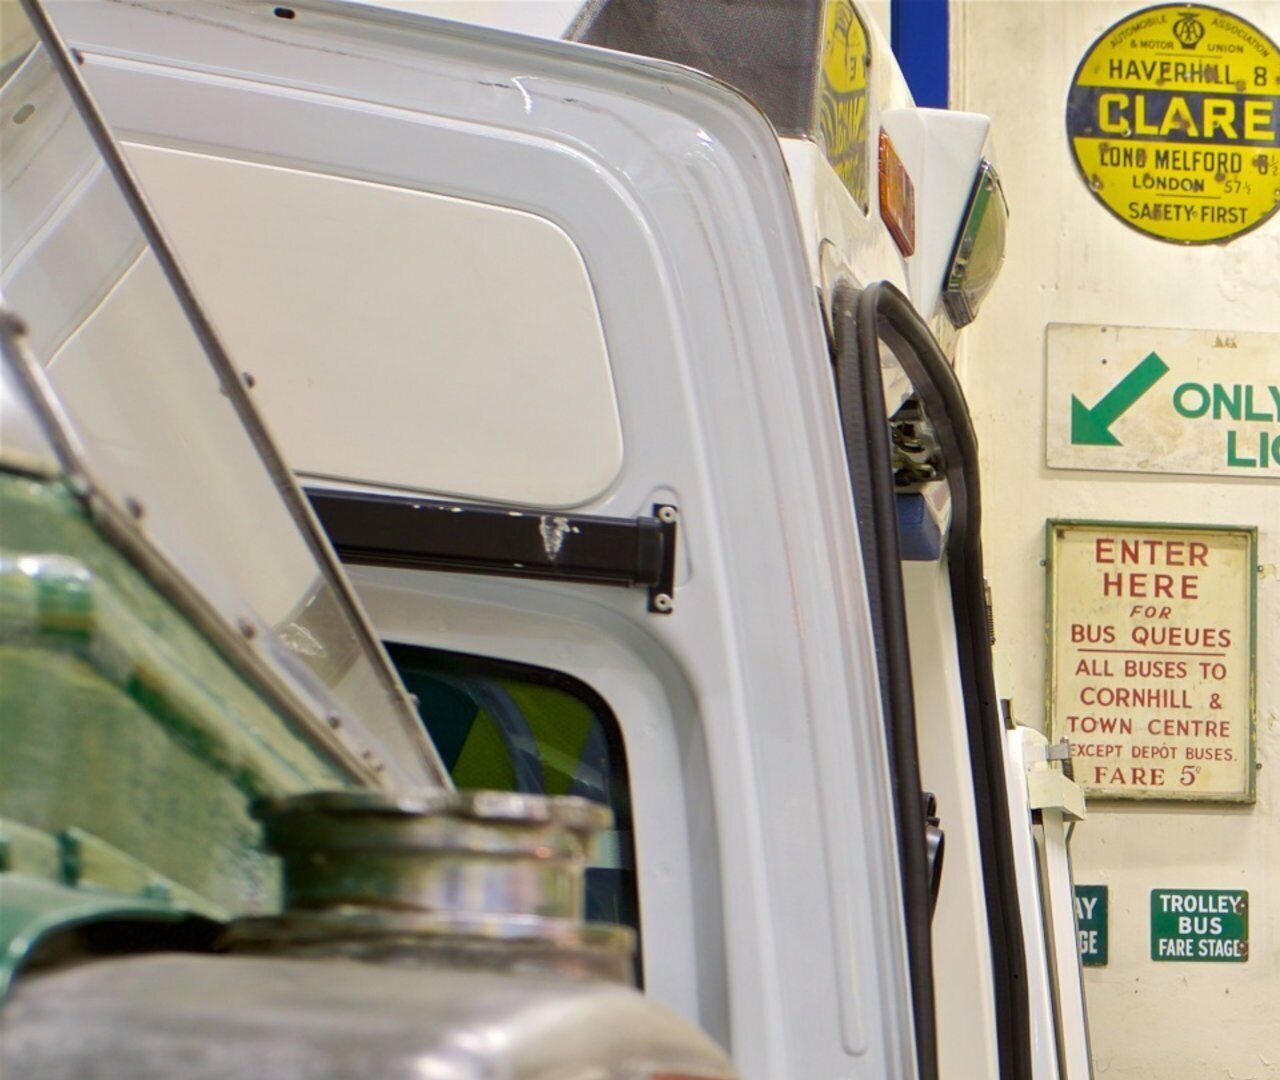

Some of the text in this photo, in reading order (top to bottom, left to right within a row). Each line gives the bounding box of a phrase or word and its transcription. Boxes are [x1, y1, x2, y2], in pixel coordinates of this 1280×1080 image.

[1109, 15, 1270, 58] AUTOMOBILE ASSOCIATION
[1140, 40, 1244, 54] MOTOR UNION
[1254, 67, 1267, 87] 8
[1099, 92, 1275, 141] CLARE
[1155, 149, 1242, 174] MELFORD
[1133, 175, 1205, 192] LONDON
[1128, 202, 1248, 224] SAFETY FIRST
[1095, 538, 1209, 567] ENTER
[1103, 572, 1199, 600] HERE
[1130, 605, 1172, 619] FOR
[1071, 623, 1232, 648] BUS QUEUES
[1075, 659, 1227, 681] ALL BUSES TO
[1080, 687, 1223, 710] CORNHILL &
[1067, 716, 1230, 738] TOWN CENTRE
[1070, 744, 1123, 758] EXCEPT
[1131, 744, 1178, 760] DEPOT
[1094, 766, 1165, 786] FARE
[1160, 895, 1242, 913] TROLLEY
[1179, 917, 1222, 934] BUS
[1159, 938, 1242, 957] FARE STAGE
